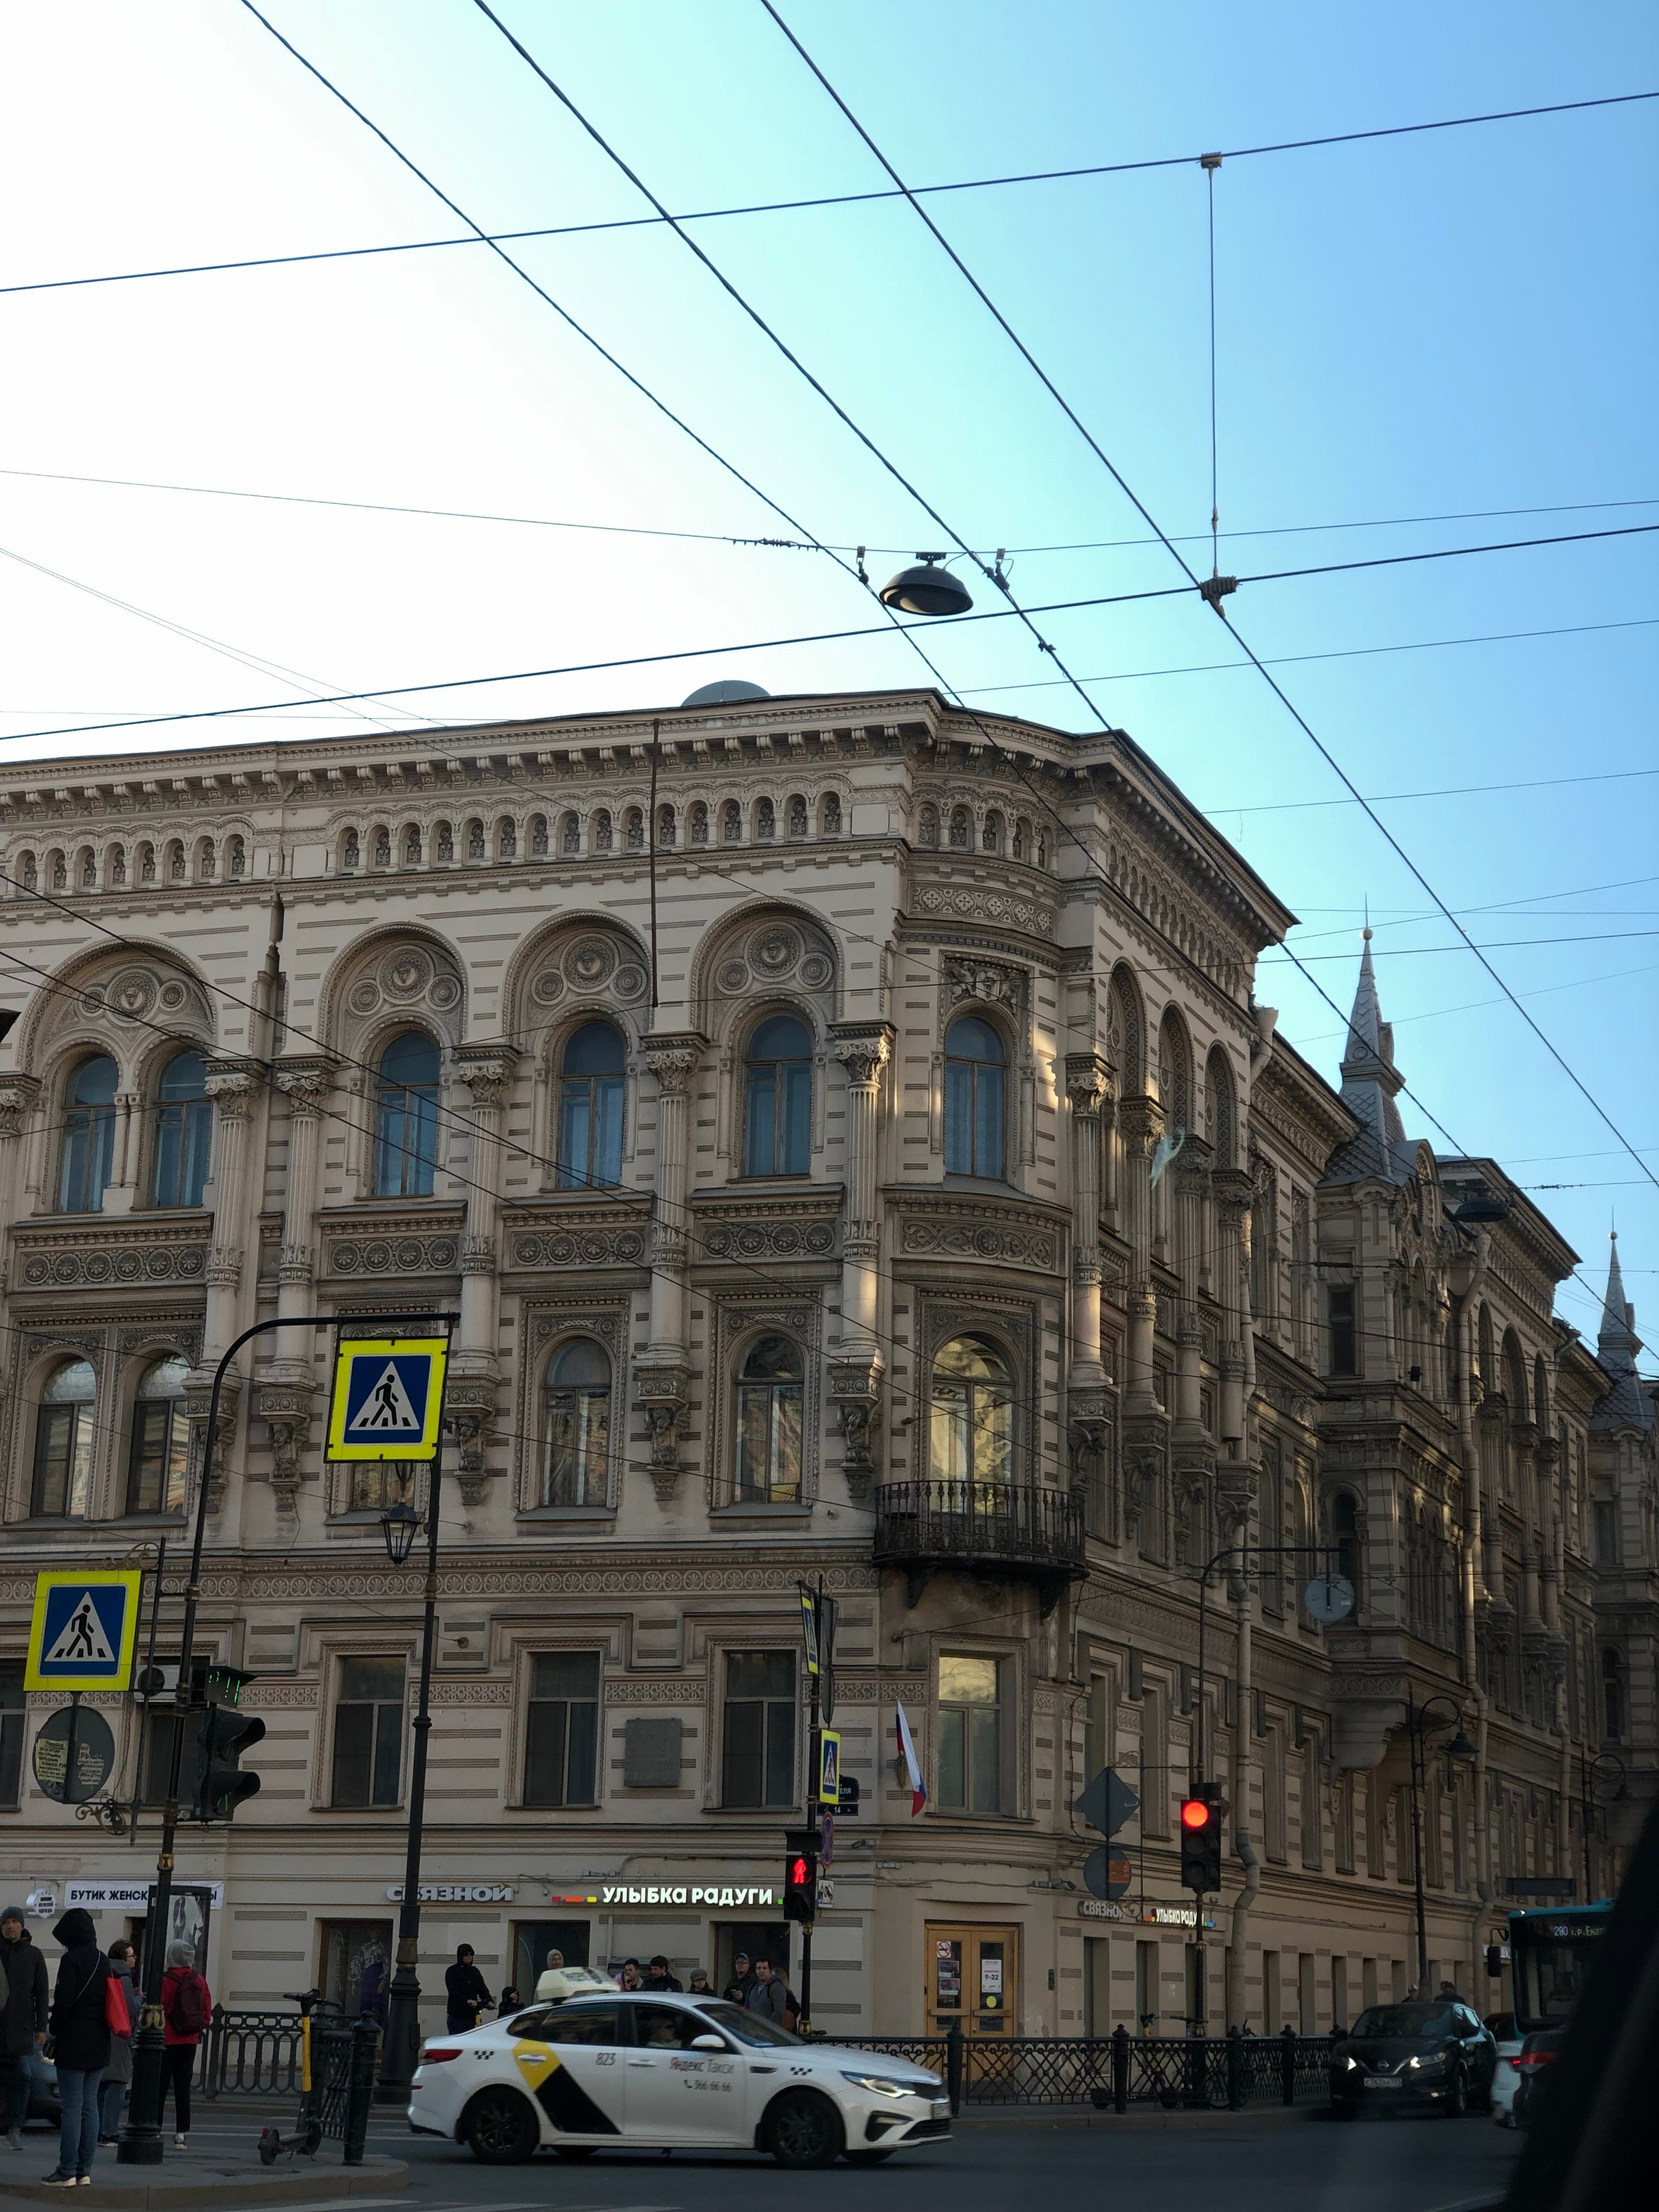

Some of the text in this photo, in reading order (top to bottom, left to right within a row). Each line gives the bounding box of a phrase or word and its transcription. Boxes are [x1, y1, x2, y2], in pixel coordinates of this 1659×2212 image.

[71, 1890, 148, 1900] БУТИК ЖЕНСК
[1554, 1926, 1568, 1936] 290
[596, 2053, 616, 2066] 823
[669, 2057, 735, 2074] Яндекс Такси
